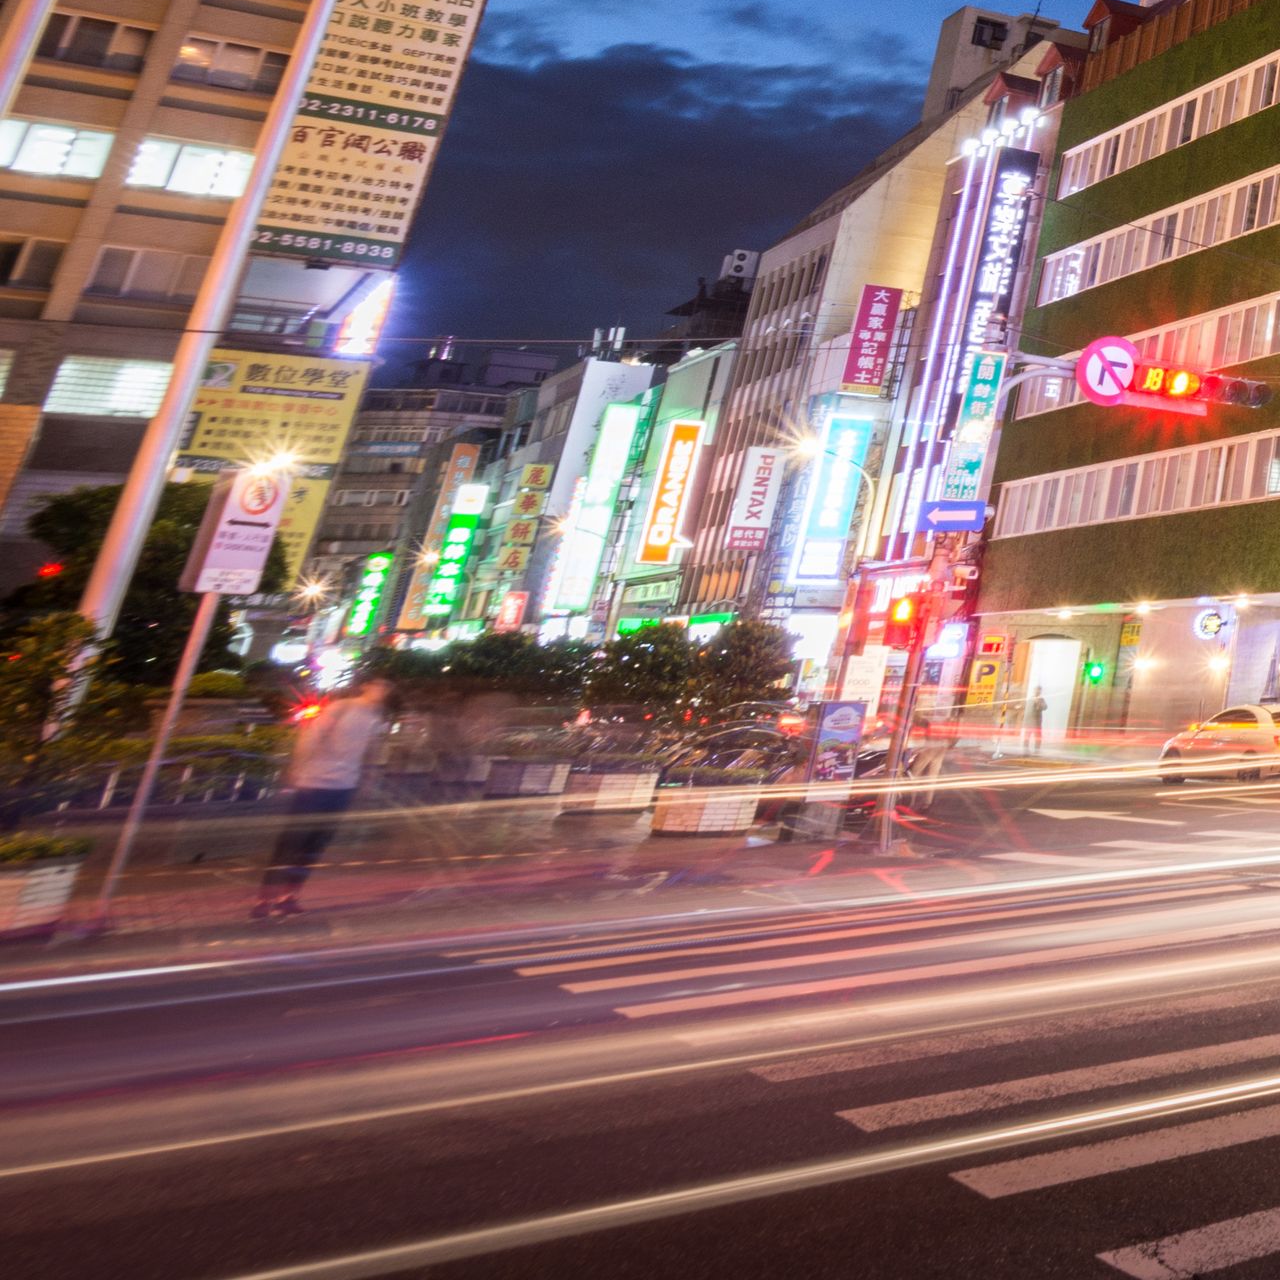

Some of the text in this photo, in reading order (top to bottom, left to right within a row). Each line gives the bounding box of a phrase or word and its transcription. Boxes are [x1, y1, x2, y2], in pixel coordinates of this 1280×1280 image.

[292, 125, 427, 163] 百官網公職
[648, 440, 694, 546] ORANGE
[744, 454, 775, 520] PENTAX
[976, 664, 995, 683] P
